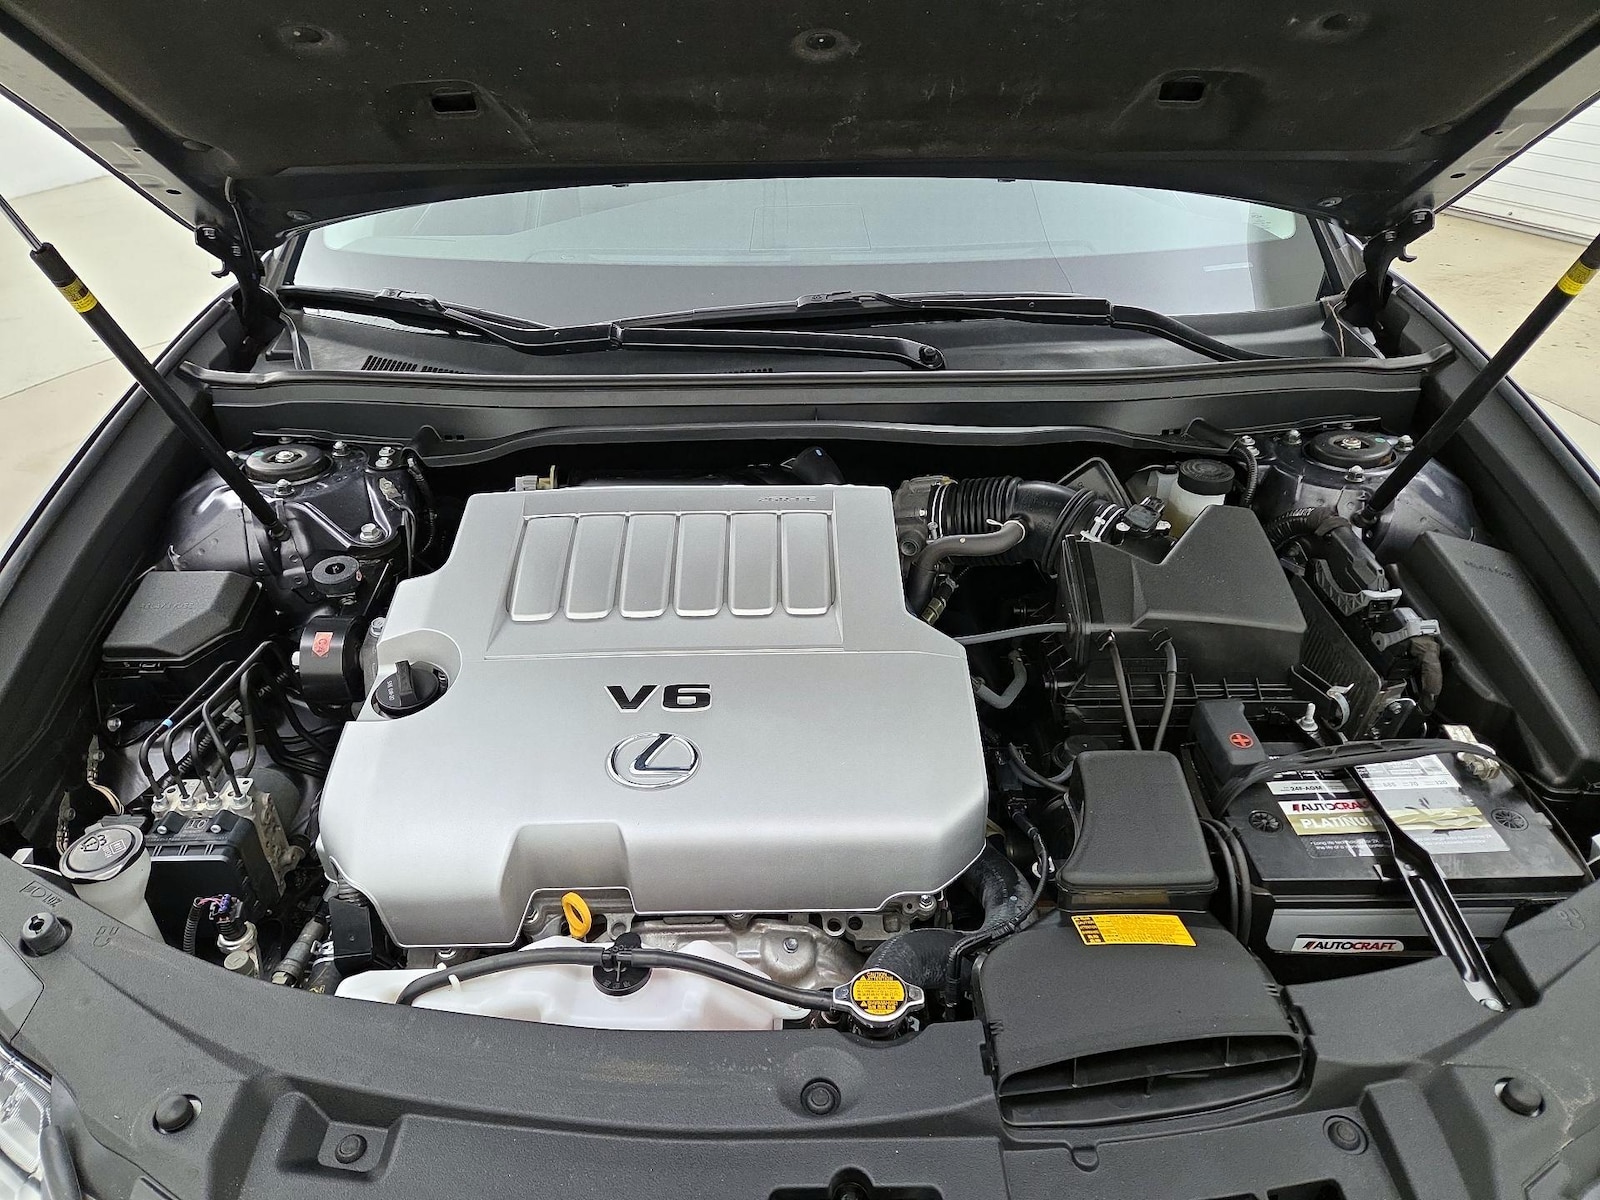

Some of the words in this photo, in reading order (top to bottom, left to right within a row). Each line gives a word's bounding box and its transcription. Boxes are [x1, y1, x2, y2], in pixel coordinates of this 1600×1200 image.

[603, 682, 712, 714] V6
[1301, 801, 1371, 812] AUTOCRA
[1312, 941, 1397, 951] AUTOCRAFT
